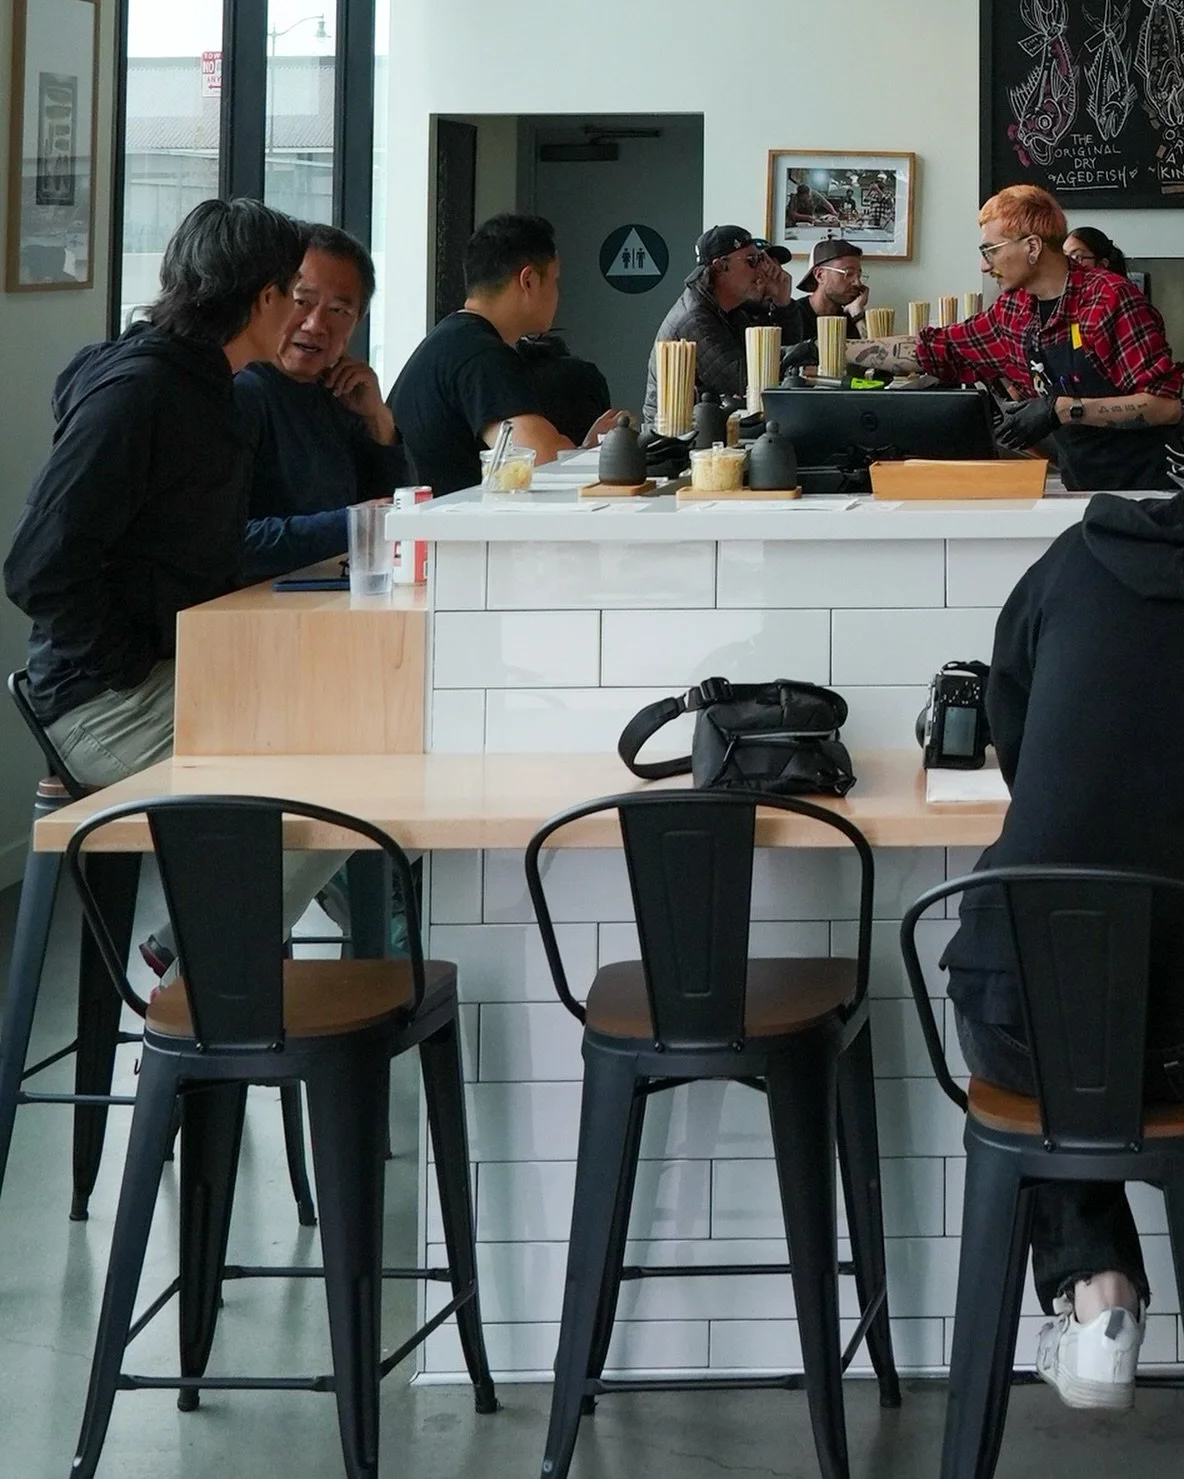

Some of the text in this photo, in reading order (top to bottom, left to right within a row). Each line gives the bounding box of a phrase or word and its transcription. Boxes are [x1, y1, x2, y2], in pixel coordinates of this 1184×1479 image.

[1071, 133, 1093, 146] THE
[1055, 144, 1121, 159] ORIGINAL
[1074, 157, 1097, 170] DRY
